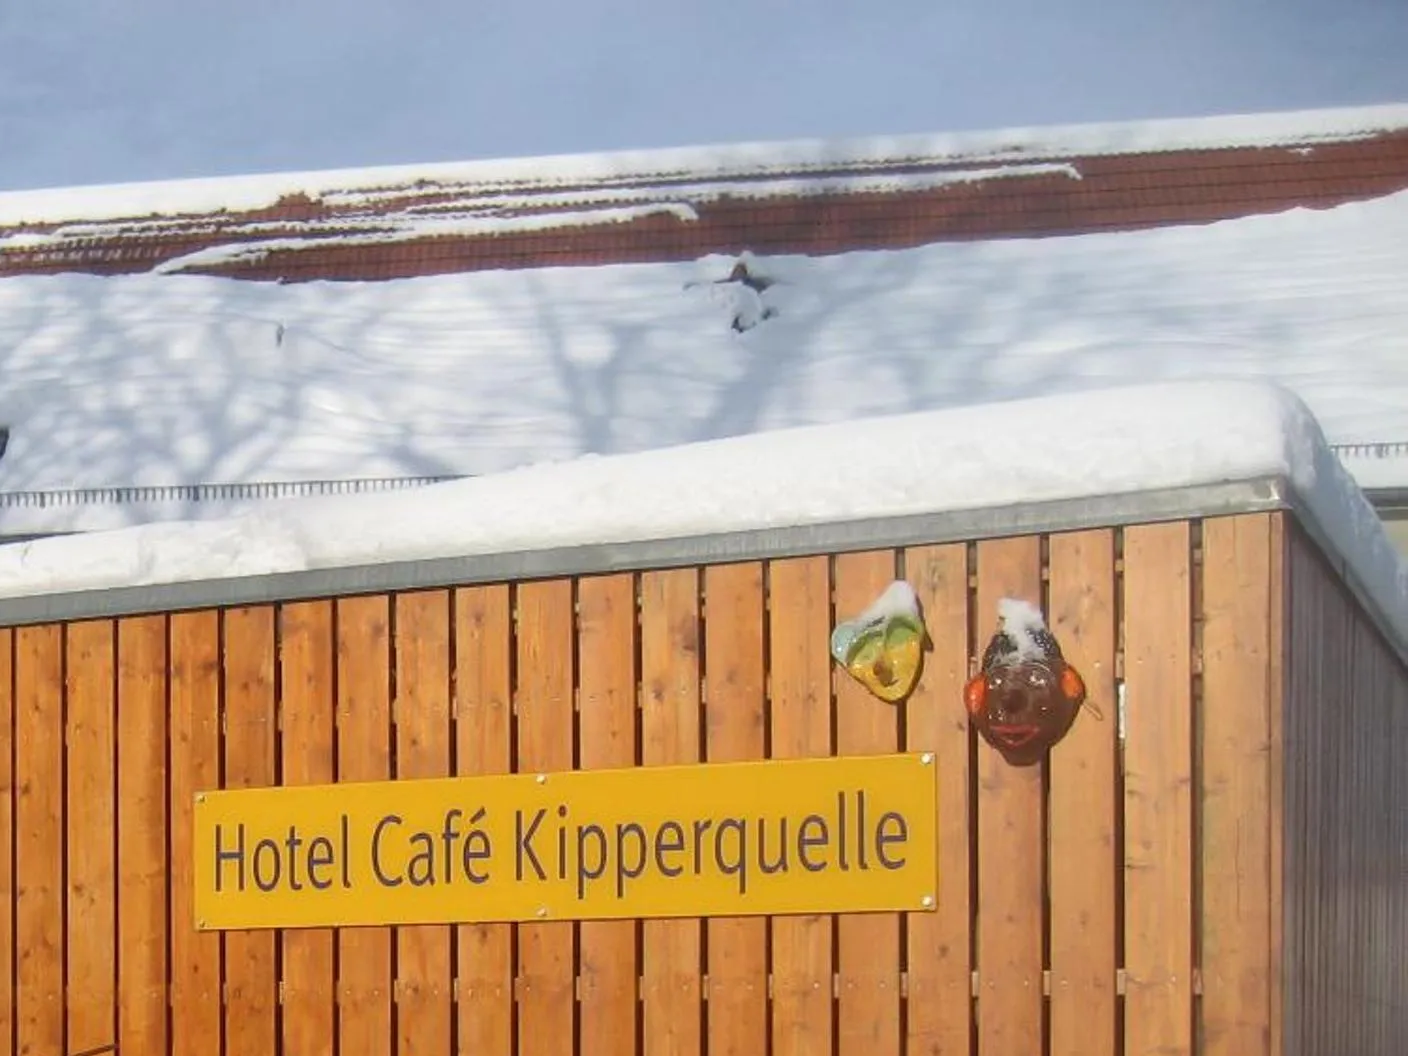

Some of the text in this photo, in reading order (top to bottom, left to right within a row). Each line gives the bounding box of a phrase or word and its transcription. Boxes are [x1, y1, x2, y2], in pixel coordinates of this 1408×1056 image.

[215, 790, 909, 899] Hotel Café Kipperquelle
